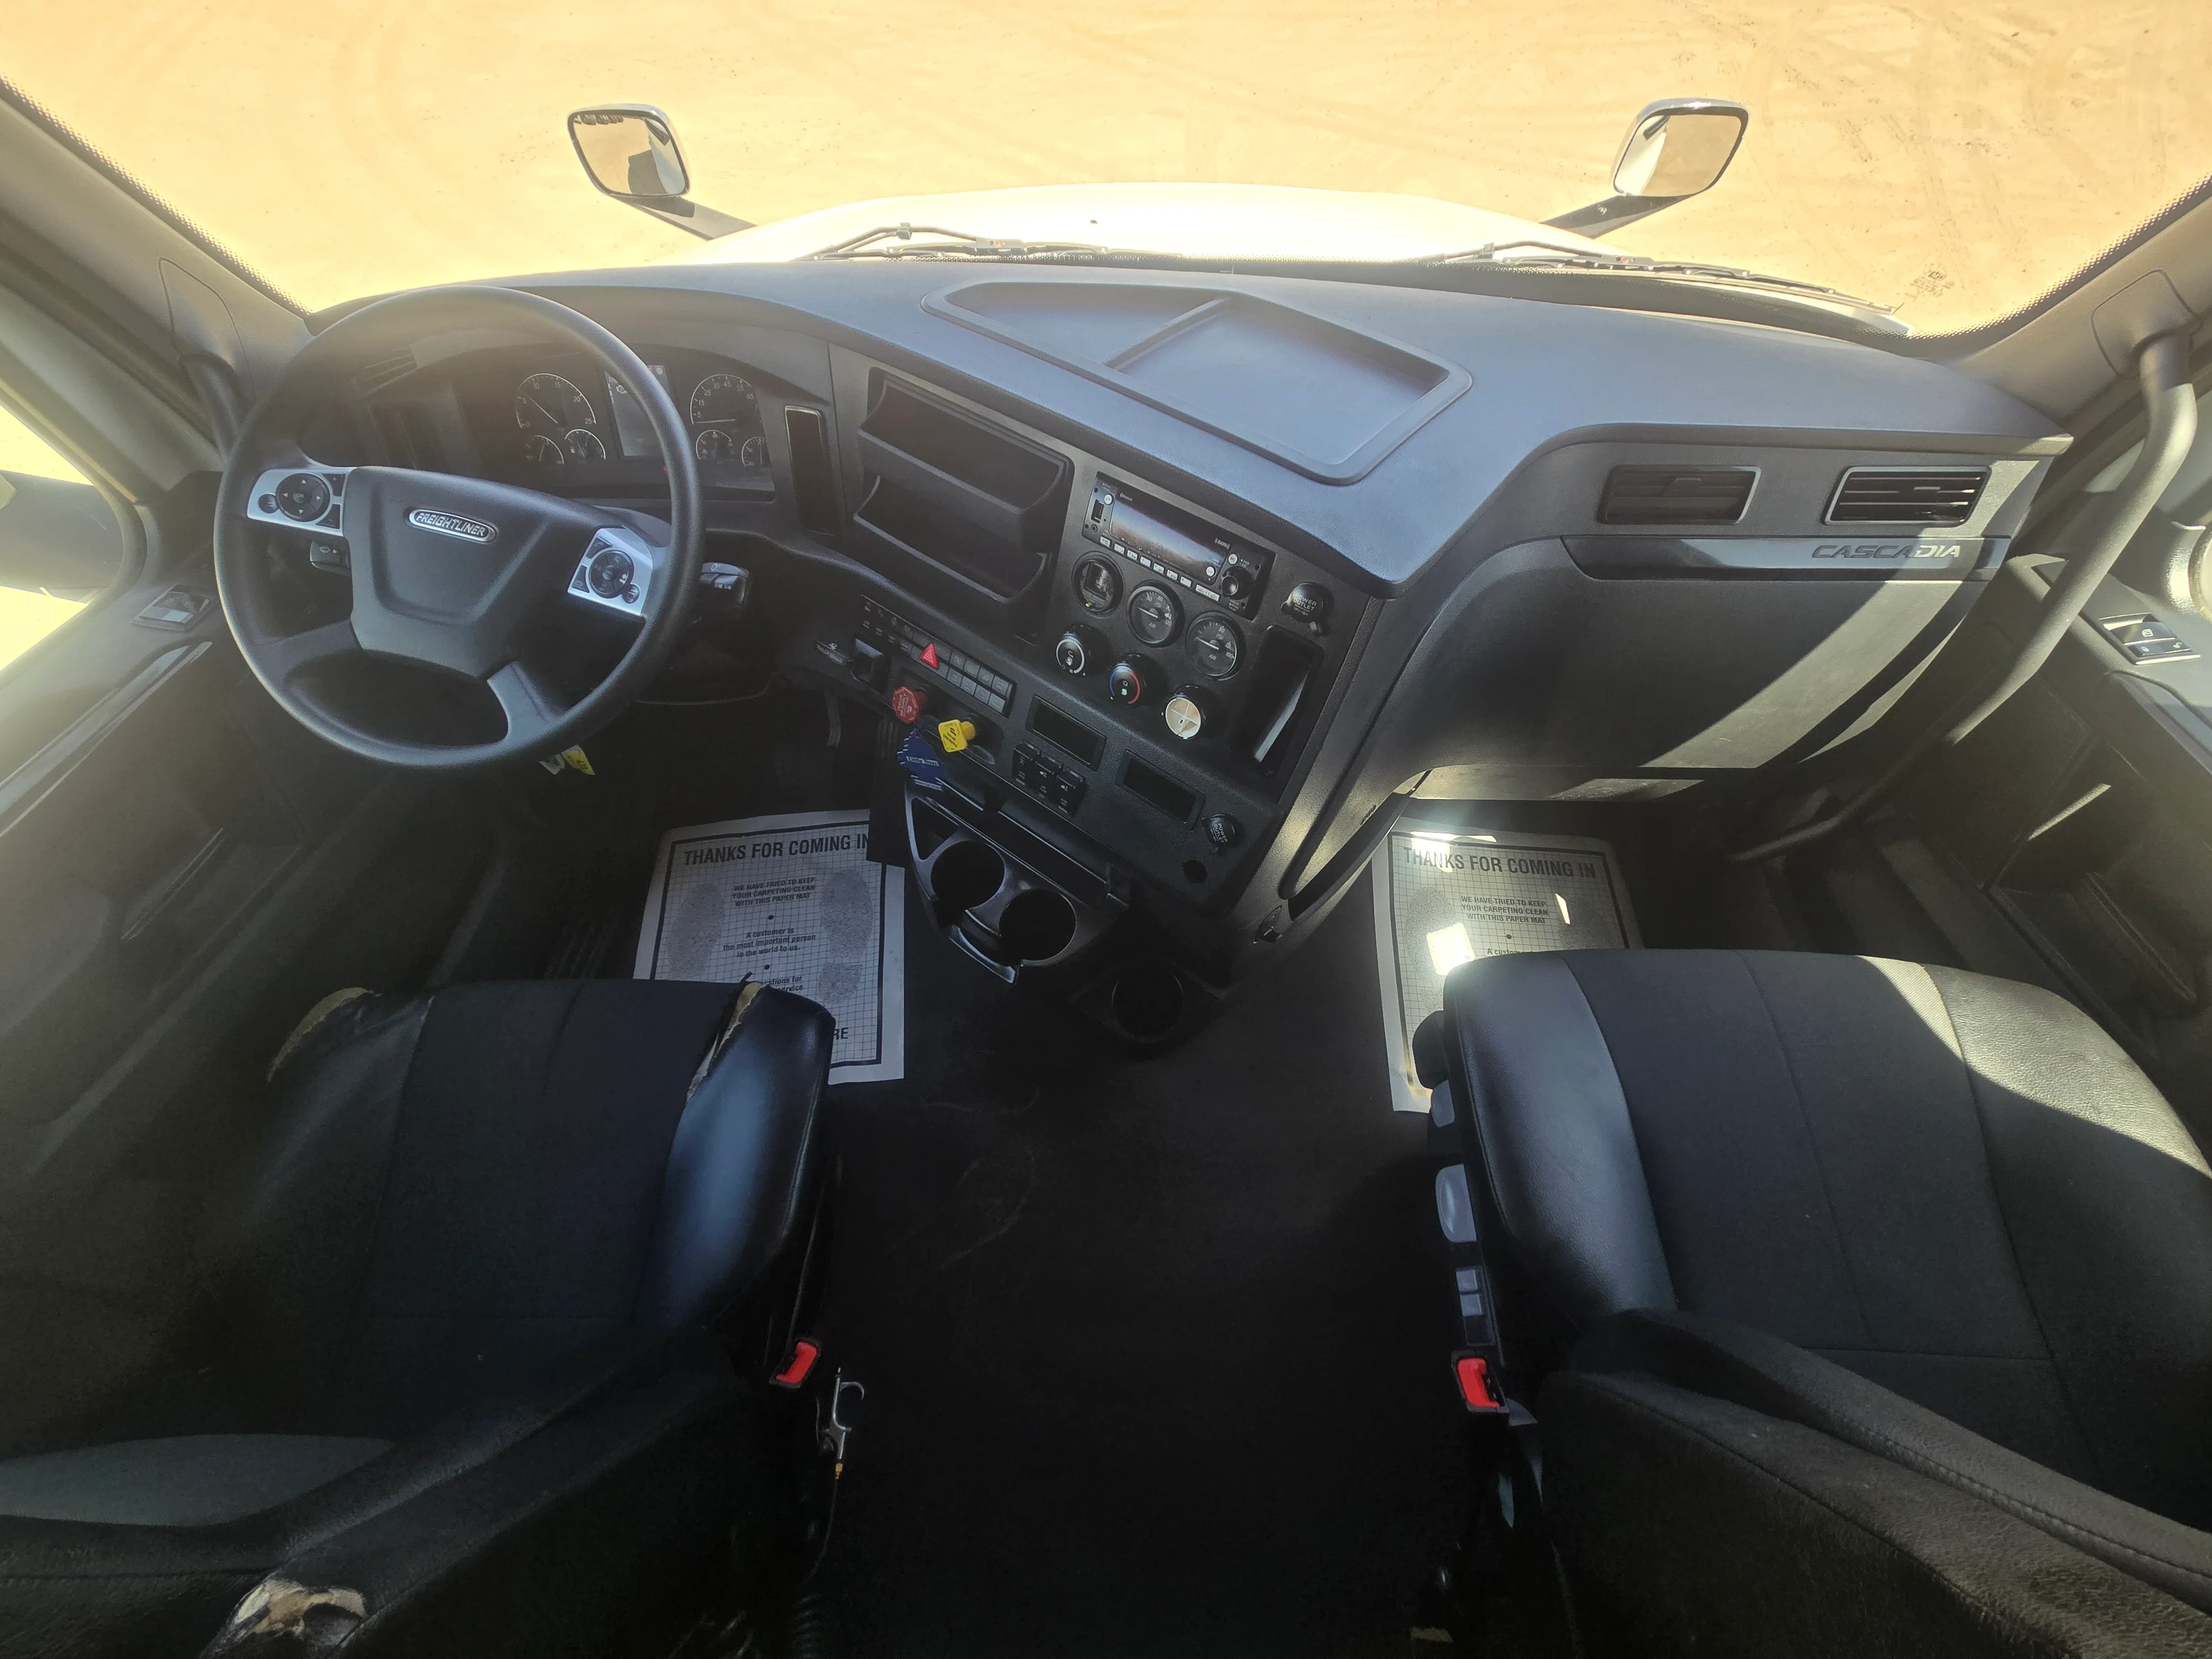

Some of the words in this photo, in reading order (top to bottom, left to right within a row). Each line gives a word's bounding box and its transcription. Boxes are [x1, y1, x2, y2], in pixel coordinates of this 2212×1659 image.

[416, 513, 486, 536] FREIGHTLINER
[1812, 545, 1961, 558] CASCADIA
[1293, 598, 1315, 611] OUTLET
[1296, 593, 1316, 606] POWER
[1214, 824, 1224, 843] OUTLET
[1218, 823, 1228, 842] POWER
[685, 844, 746, 865] THANKS
[752, 841, 783, 858] FOR
[789, 834, 851, 855] COMING
[1404, 846, 1464, 870] THANKS
[1469, 855, 1503, 873] FOR
[1507, 858, 1574, 878] COMING
[1579, 863, 1596, 878] IN
[753, 886, 791, 898] CARPETING
[772, 894, 794, 902] PAPER
[1484, 906, 1523, 914] CARPETING
[753, 928, 786, 938] customer
[737, 941, 754, 950] most
[755, 936, 790, 947] important
[791, 935, 816, 943] person
[759, 946, 778, 954] world
